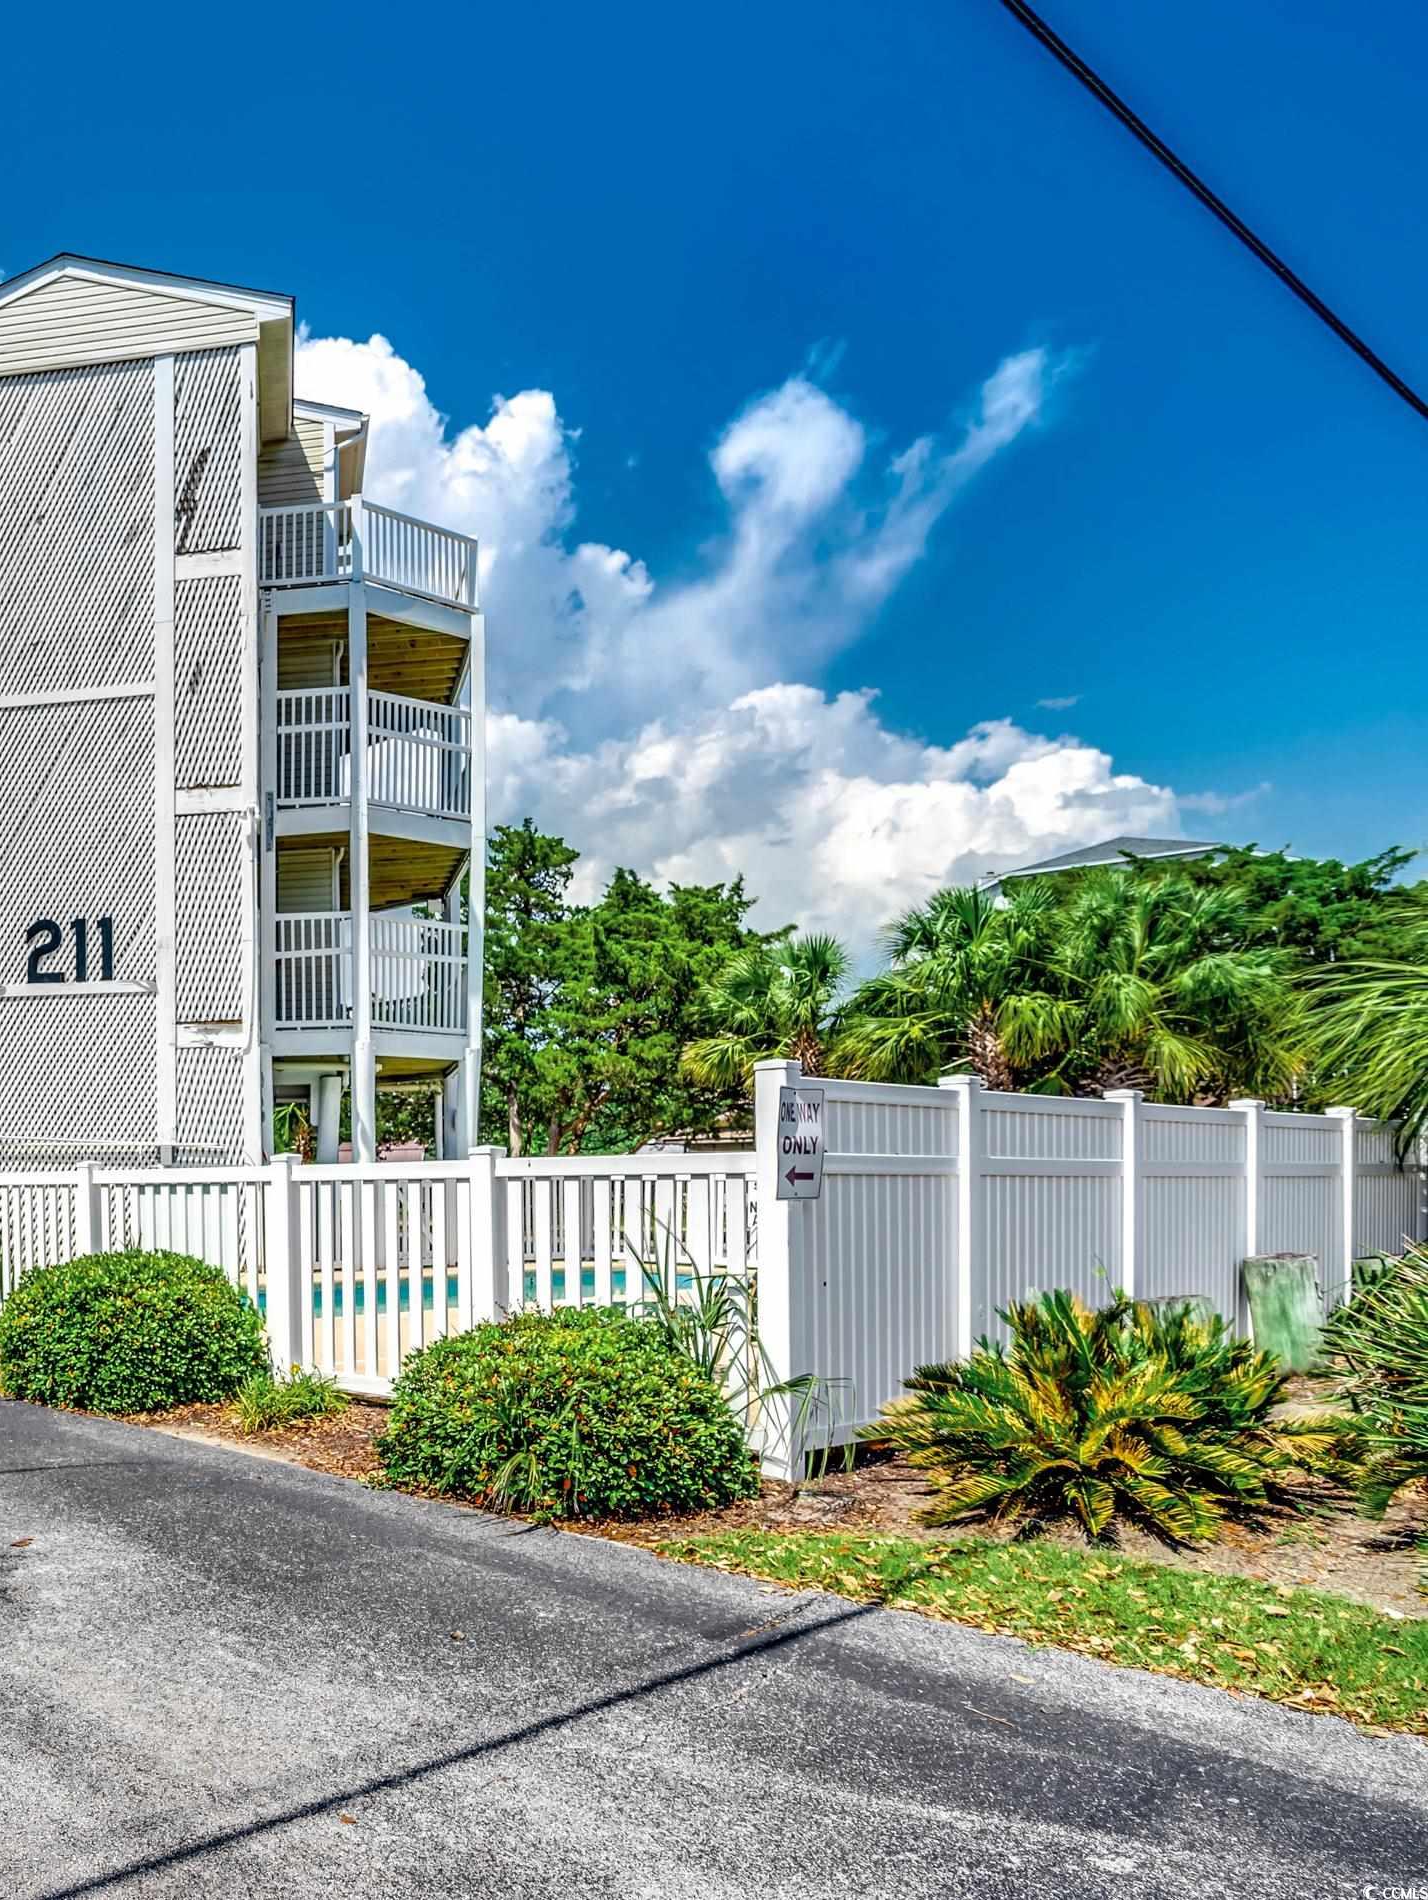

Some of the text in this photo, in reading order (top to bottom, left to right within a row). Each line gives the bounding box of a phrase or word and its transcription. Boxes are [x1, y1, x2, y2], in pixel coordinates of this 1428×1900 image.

[25, 917, 113, 984] 211
[780, 1101, 821, 1123] ONE WAY
[782, 1135, 819, 1155] ONLY
